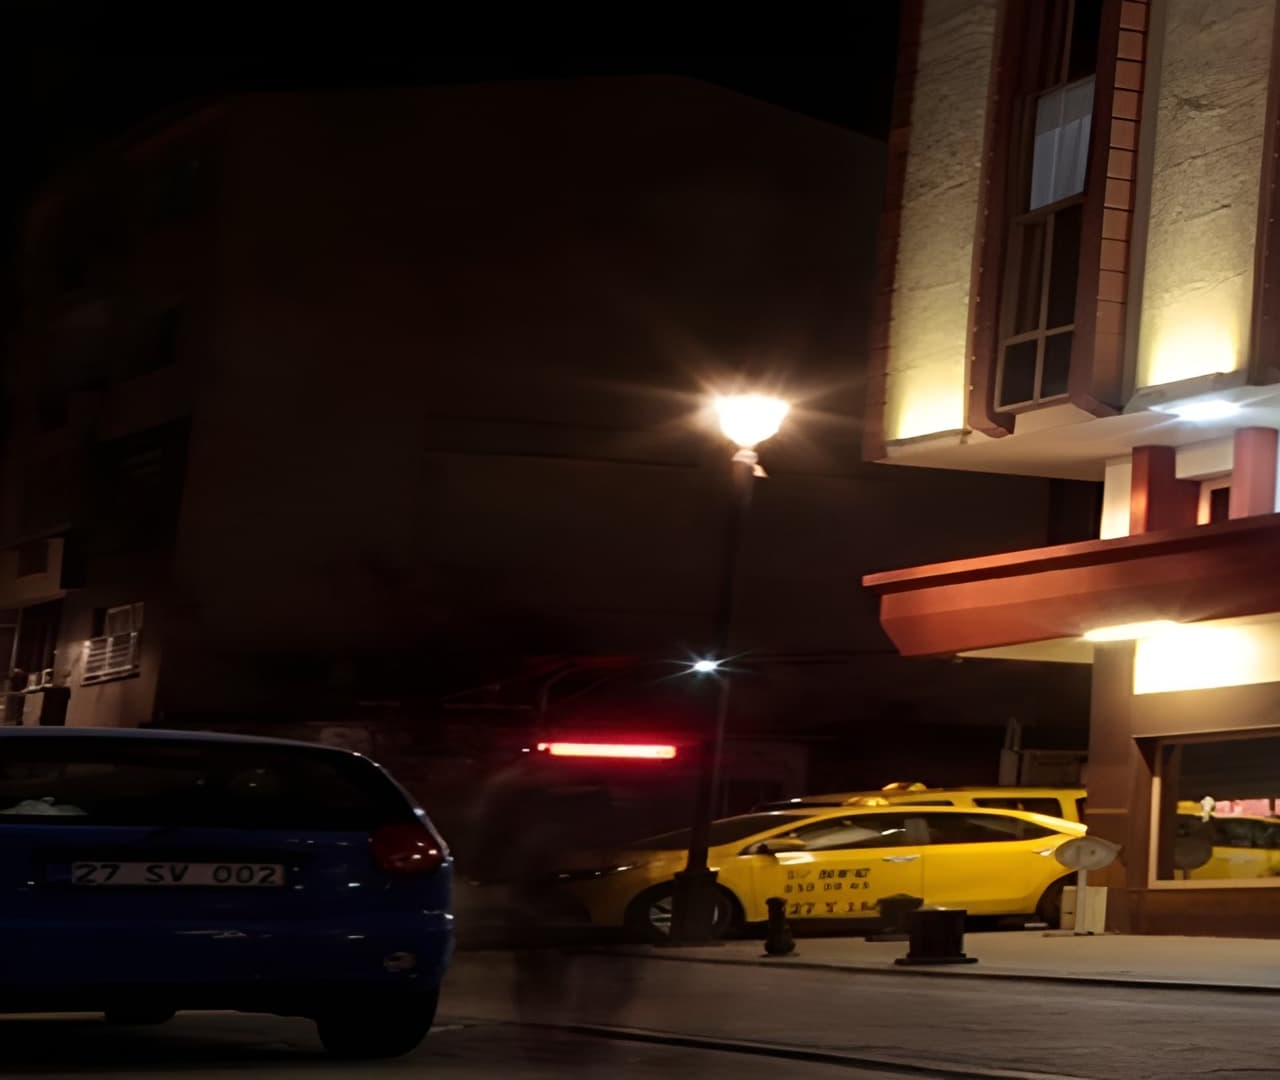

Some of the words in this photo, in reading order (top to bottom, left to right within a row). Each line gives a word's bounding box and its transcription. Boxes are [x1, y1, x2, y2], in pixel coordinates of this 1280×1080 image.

[74, 863, 121, 884] 27
[144, 864, 190, 883] SV
[213, 865, 277, 884] 002
